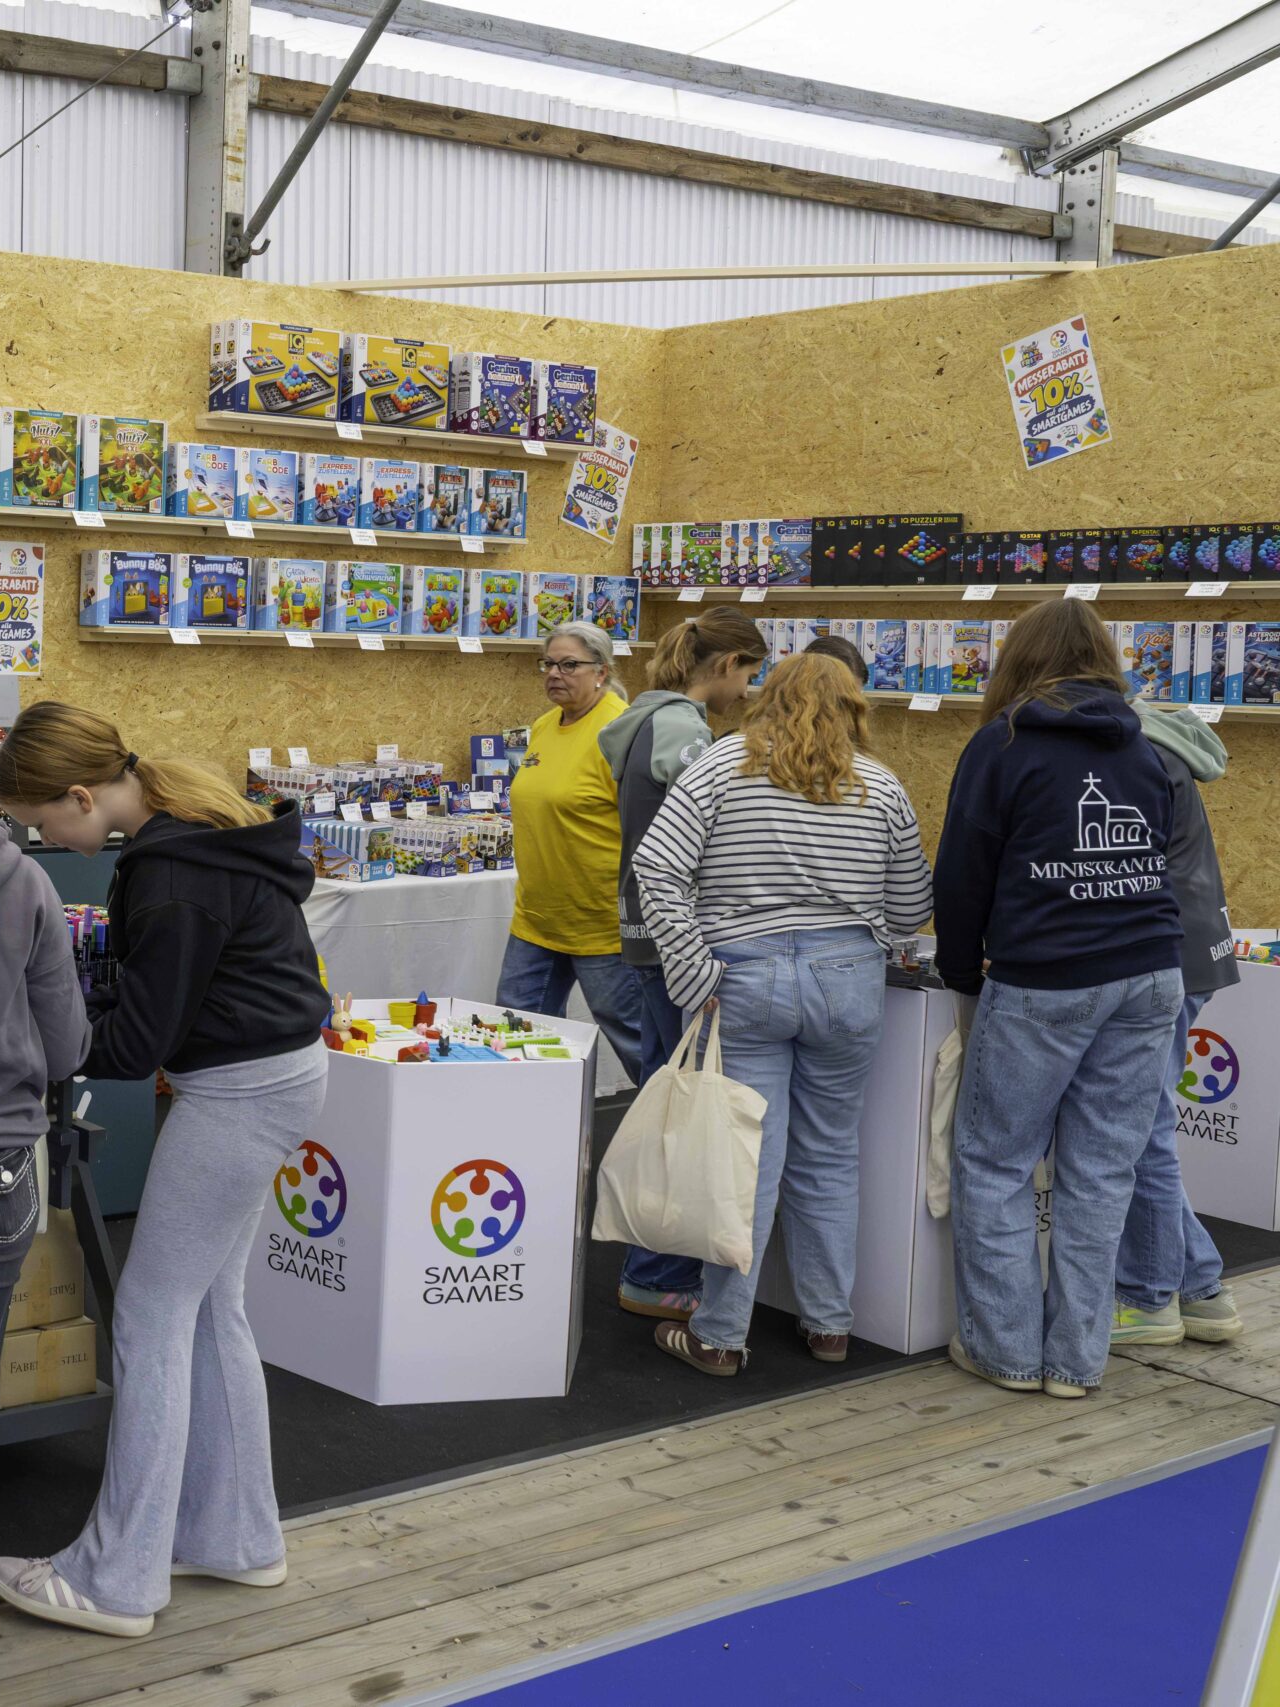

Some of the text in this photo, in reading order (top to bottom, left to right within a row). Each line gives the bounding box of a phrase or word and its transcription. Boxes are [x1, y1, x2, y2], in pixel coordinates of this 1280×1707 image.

[290, 334, 304, 349] IQ
[403, 348, 416, 362] IQ
[487, 361, 519, 374] Genius
[1017, 352, 1086, 394] MESSERABATT
[554, 370, 584, 382] Genius
[1030, 373, 1083, 414] 10%
[1032, 400, 1092, 434] SMARTGAMES
[30, 424, 62, 439] Nuts!
[117, 432, 148, 446] Nuts!
[196, 452, 217, 462] FARB
[257, 457, 278, 466] FARB
[581, 452, 627, 475] MESSERABATT
[206, 461, 228, 470] CODE
[267, 466, 288, 475] CODE
[584, 464, 618, 495] 10%
[576, 489, 615, 511] SMARTGAMES
[116, 559, 167, 572] Bunny Boo
[195, 563, 244, 576] Bunny Boo
[436, 574, 451, 582] Dino
[494, 577, 509, 585] Dino
[462, 783, 470, 791] IQ
[1029, 855, 1168, 879] MINISTRANTE
[1070, 876, 1163, 900] GURTWEIL
[1176, 1104, 1240, 1129] MART
[1175, 1121, 1238, 1145] AMES
[269, 1233, 348, 1272] SMART
[268, 1253, 346, 1292] GAMES
[424, 1263, 526, 1284] SMART
[423, 1283, 524, 1305] GAMES
